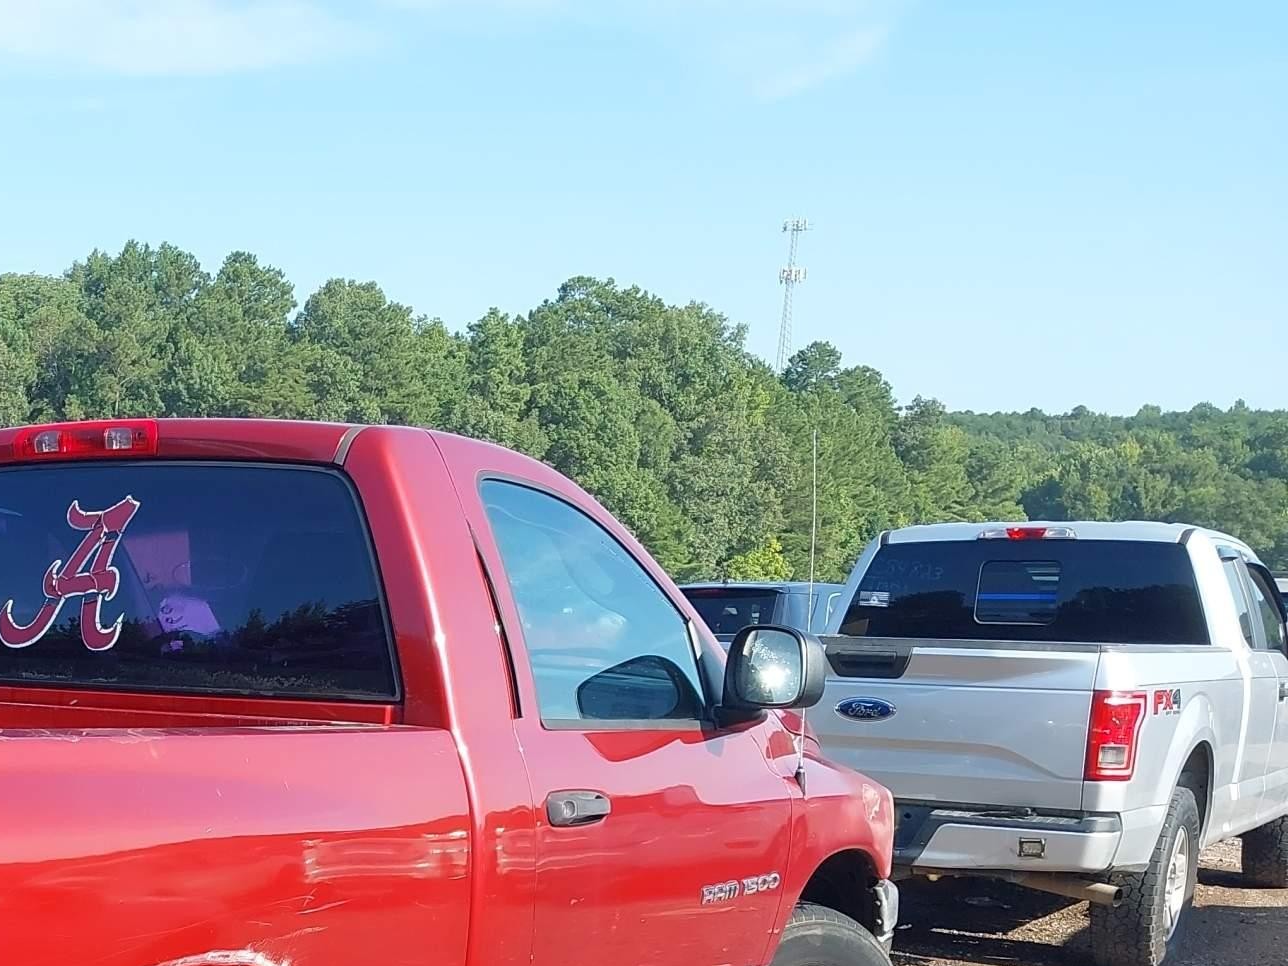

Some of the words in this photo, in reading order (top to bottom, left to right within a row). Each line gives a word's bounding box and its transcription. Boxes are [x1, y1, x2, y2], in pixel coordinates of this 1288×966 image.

[1153, 688, 1181, 715] FX4
[701, 880, 740, 905] RAM
[742, 872, 780, 896] 1500
